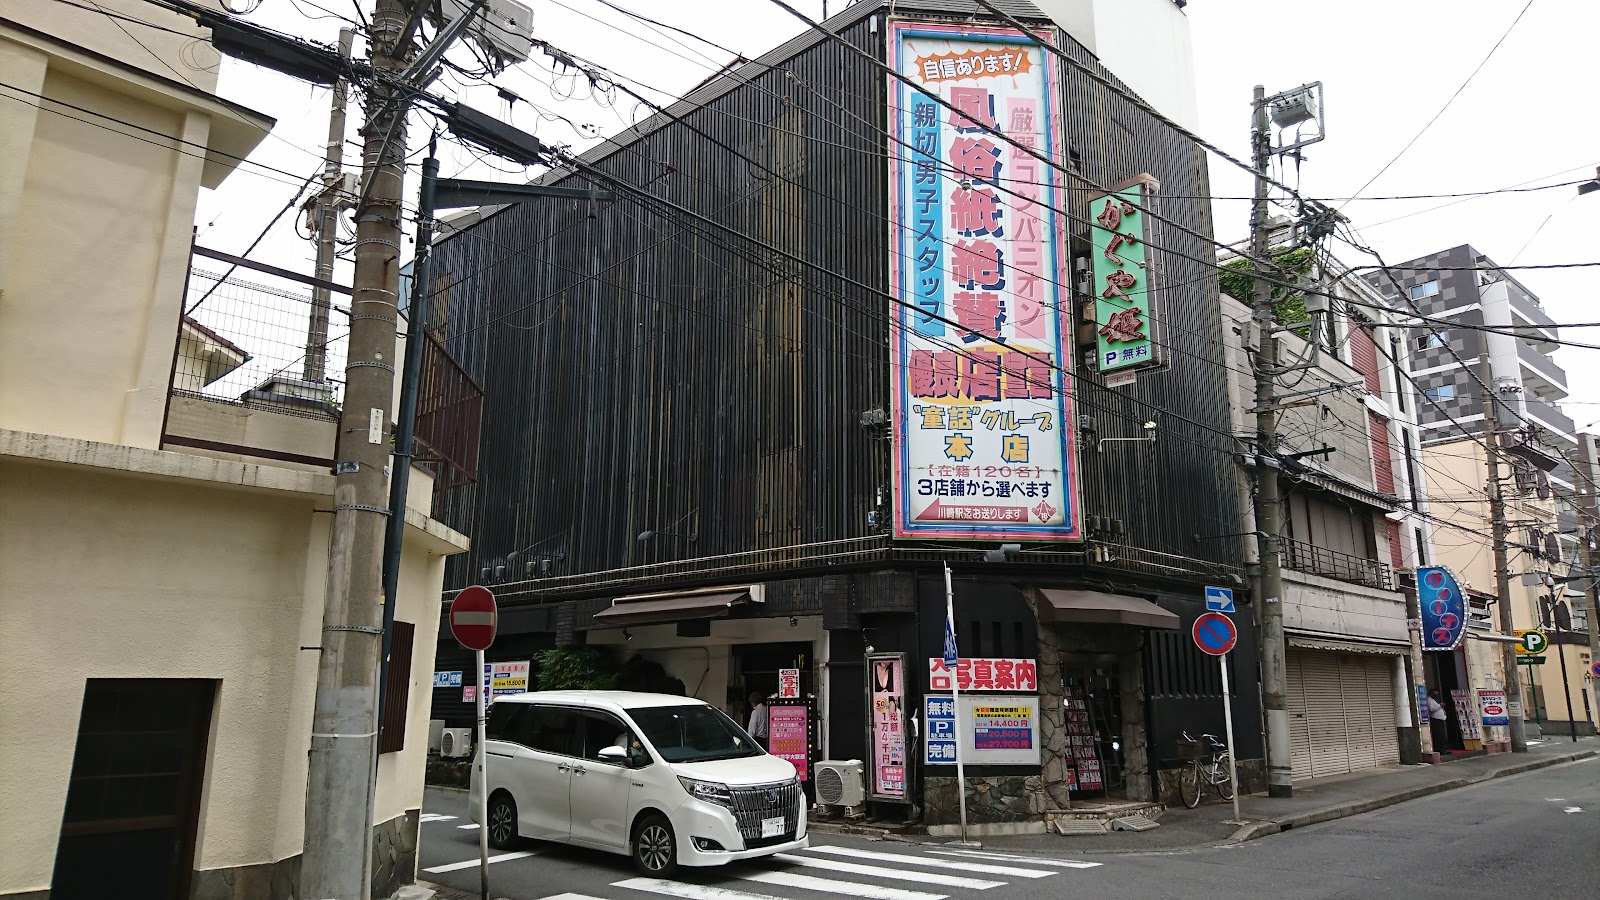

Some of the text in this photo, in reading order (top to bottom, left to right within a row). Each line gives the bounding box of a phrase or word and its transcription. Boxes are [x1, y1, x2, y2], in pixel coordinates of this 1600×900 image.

[922, 52, 1023, 81] 自信あります!
[914, 102, 941, 325] 親切男子スタッフ
[948, 86, 1007, 344] 風俗紙絶賛
[1010, 106, 1041, 327] 厳選コンパニオン
[1097, 198, 1147, 345] かぐや姫
[1105, 345, 1147, 366] P 無料
[917, 478, 1052, 498] 3店舗から選べます
[937, 507, 1022, 520] 川崎駅迄お送りします
[1526, 634, 1542, 650] P
[956, 659, 1036, 690] 写真案内
[783, 675, 796, 697] 写真
[927, 701, 955, 716] 無料
[880, 712, 890, 764] 1万4千円
[935, 721, 949, 734] P
[928, 743, 956, 759] 完備
